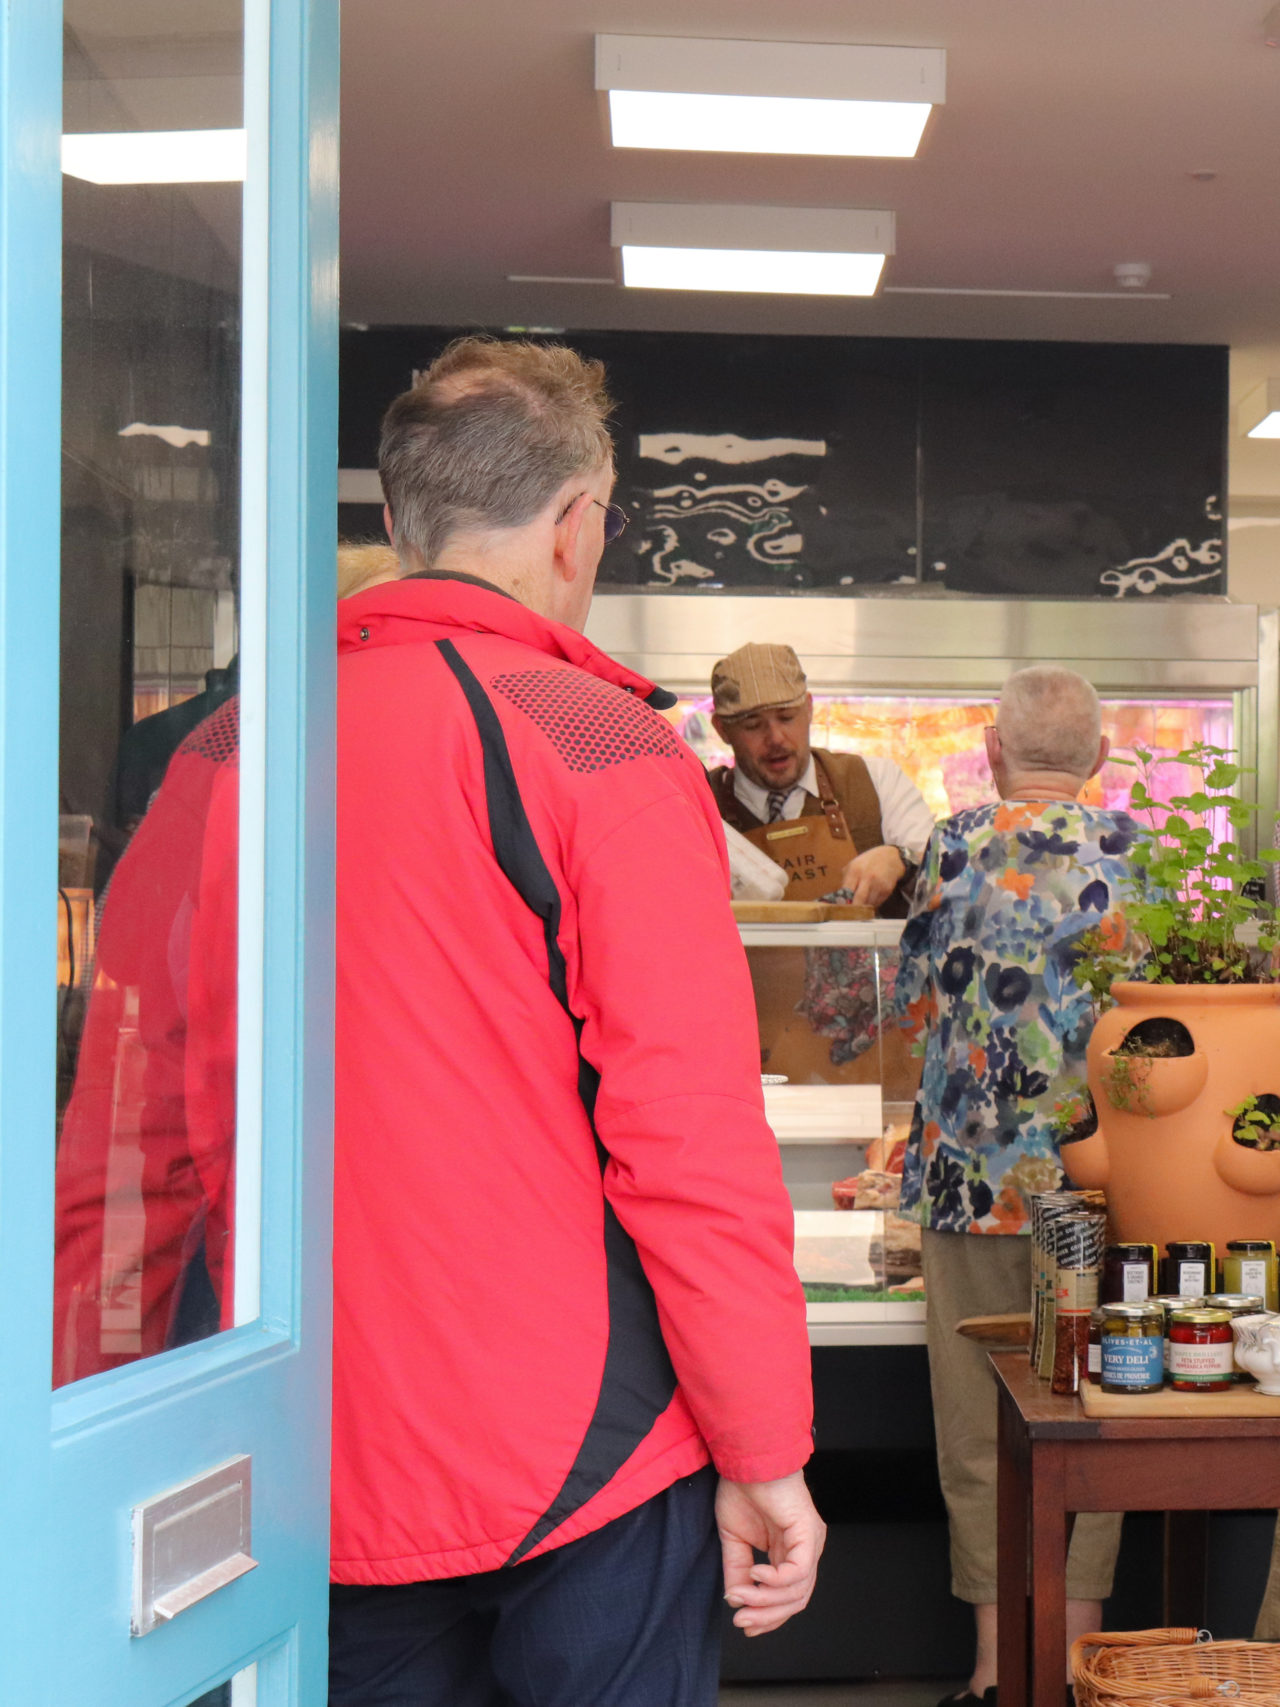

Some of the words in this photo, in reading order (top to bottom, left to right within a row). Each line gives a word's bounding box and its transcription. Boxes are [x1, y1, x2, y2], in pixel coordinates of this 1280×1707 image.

[774, 854, 816, 870] AIR
[791, 864, 828, 882] AST
[1104, 1354, 1124, 1364] VERY
[1126, 1355, 1149, 1364] DELI
